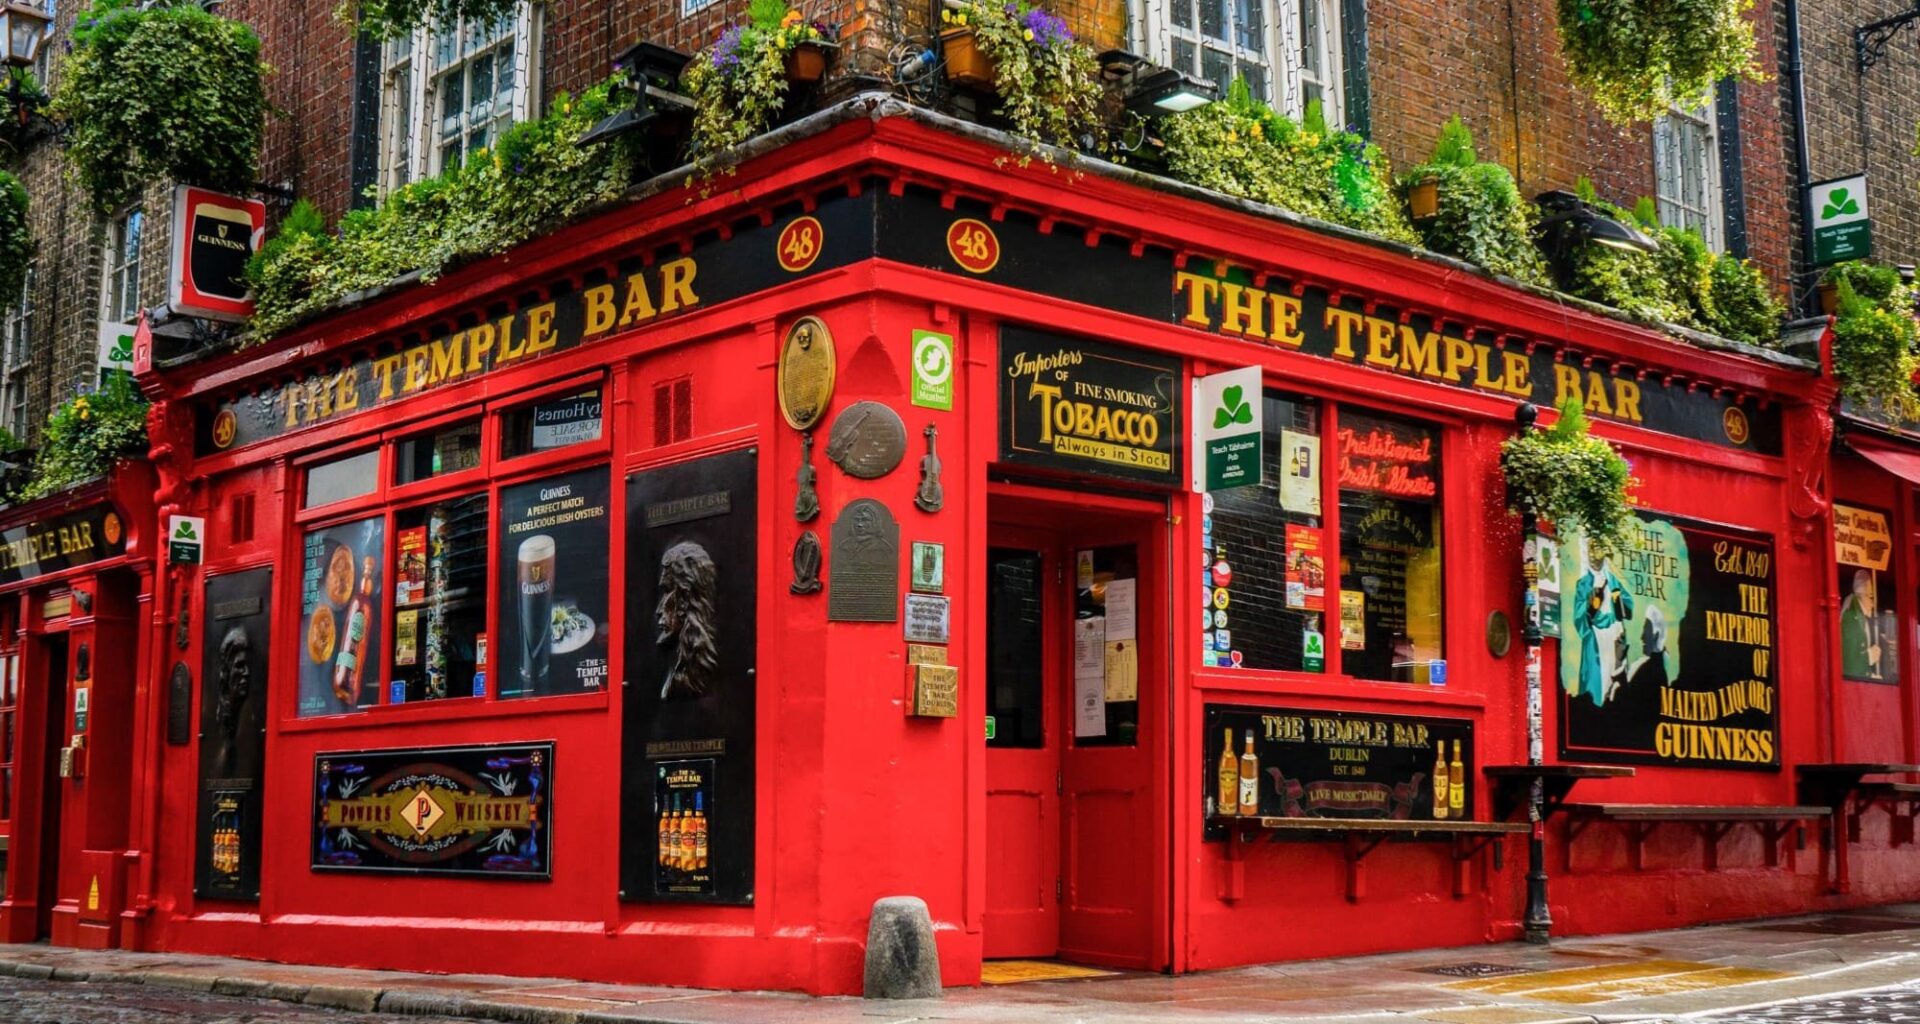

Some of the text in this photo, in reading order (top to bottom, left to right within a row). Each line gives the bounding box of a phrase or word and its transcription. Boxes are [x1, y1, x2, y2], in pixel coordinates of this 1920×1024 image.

[198, 234, 245, 251] GUINNESS
[784, 222, 813, 262] 48
[956, 226, 988, 260] 48
[284, 257, 699, 427] THE TEMPLE BAR
[1176, 271, 1642, 422] THE TEMPLE BAR
[1008, 349, 1083, 382] Importers
[1055, 370, 1069, 381] OF
[1075, 381, 1158, 409] FINE SMOKING
[216, 418, 233, 440] 48
[1727, 414, 1744, 436] 48
[1056, 436, 1168, 467] Always in Stock
[1338, 429, 1431, 461] Traditional
[1338, 456, 1435, 496] Irish Music
[508, 505, 604, 534] FOR DELICIOUS IRISH OYSTERS
[527, 496, 584, 517] A PERFECT MATCH
[1357, 508, 1400, 533] TEMPLE
[1852, 512, 1879, 533] Garden
[0, 520, 94, 570] TEMPLE BAR
[1834, 527, 1865, 550] Smoking
[1620, 550, 1680, 579] TEMPLE
[1745, 550, 1769, 579] 1840
[1841, 546, 1859, 563] Area
[1634, 573, 1667, 602] BAR
[1739, 583, 1769, 615] THE
[1705, 610, 1770, 647] EMPEROR
[576, 664, 608, 679] TEMPLE
[585, 658, 599, 667] THE
[1752, 649, 1770, 678] OF
[583, 676, 600, 688] BAR
[1660, 679, 1773, 722] MALTED LIQUORS
[1261, 715, 1430, 748] THE TEMPLE BAR
[1655, 722, 1773, 763] GUINNESS
[1330, 747, 1370, 762] DUBLIN
[1309, 789, 1388, 802] LIVE MUSIC DAILY
[340, 797, 522, 827] POWERS P WHISKEY
